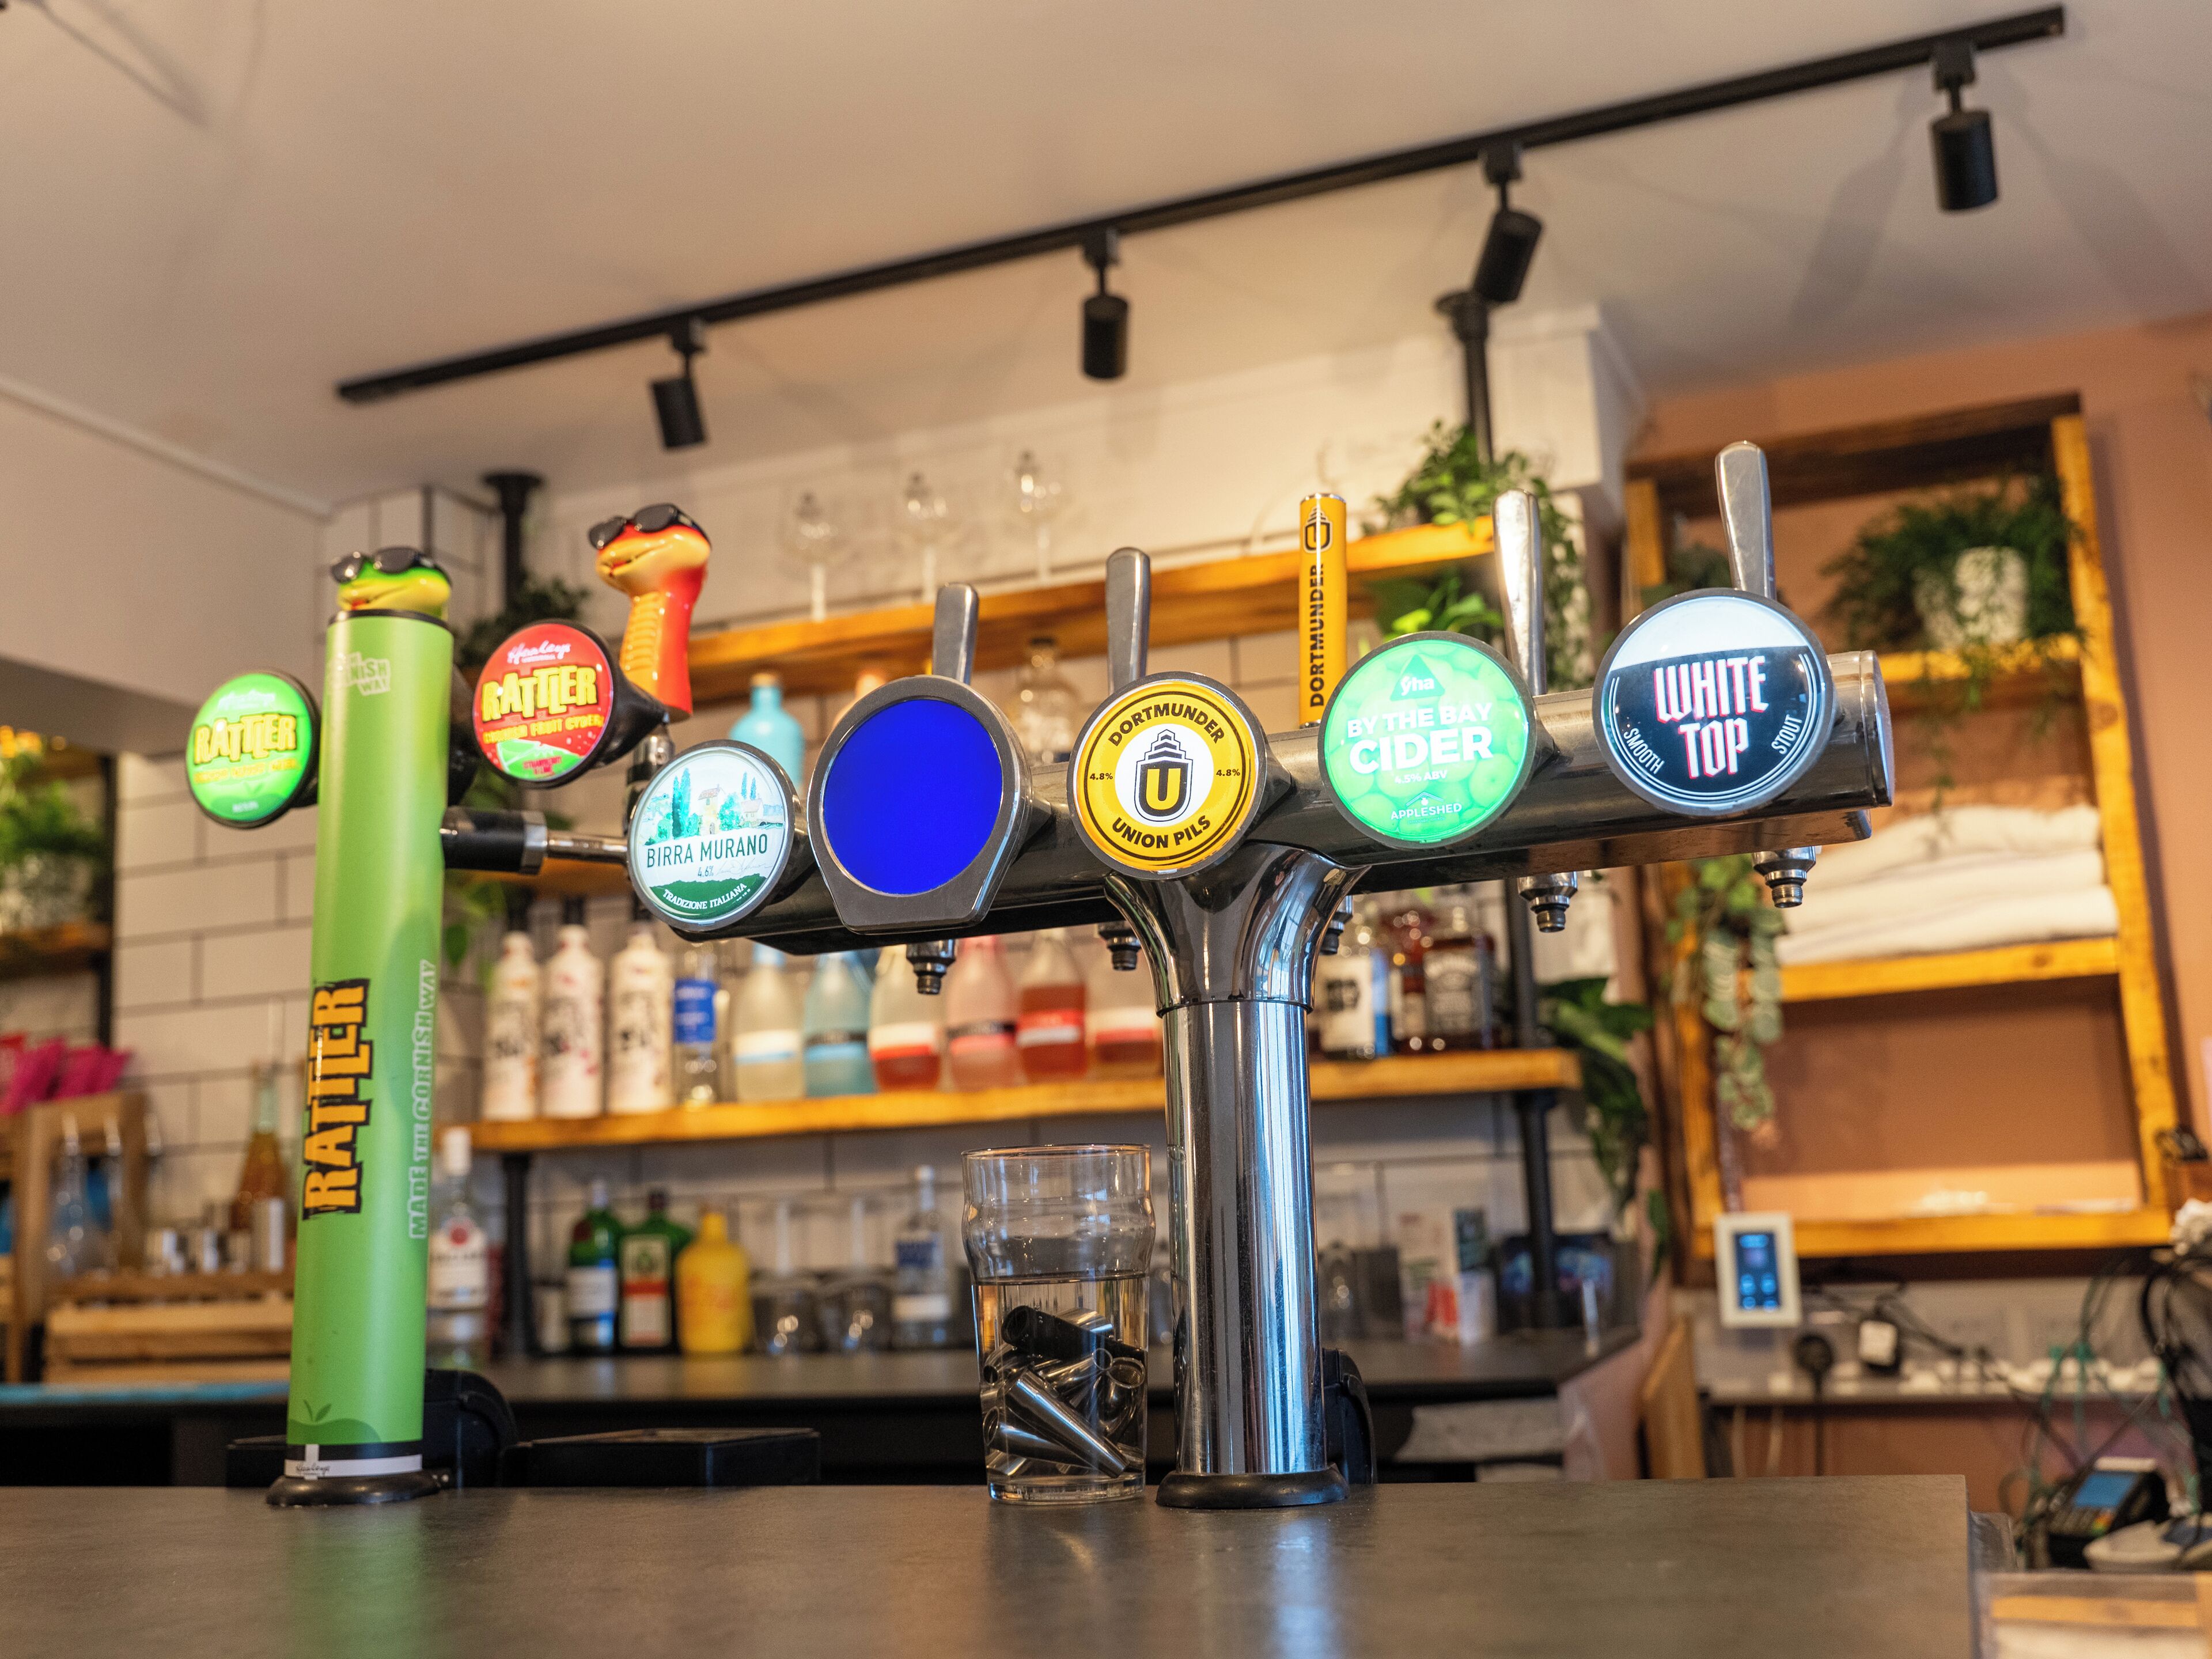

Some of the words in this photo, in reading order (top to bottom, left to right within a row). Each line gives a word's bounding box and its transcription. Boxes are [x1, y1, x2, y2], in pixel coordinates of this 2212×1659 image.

[1310, 563, 1324, 707] DORTMUNDER
[482, 665, 597, 722] RATTLER
[1400, 676, 1435, 696] yha
[1653, 655, 1770, 724] WHITE
[194, 714, 297, 764] RATTLER
[530, 718, 562, 737] FRUIT
[1108, 703, 1225, 747] DORTMUNDER
[1347, 715, 1378, 738] BY
[1382, 707, 1435, 731] THE
[1440, 703, 1493, 725] BAY
[1771, 714, 1803, 755] STOUT
[1349, 726, 1494, 775] CIDER
[1623, 728, 1665, 774] SMOOTH
[1678, 717, 1749, 779] TOP
[1215, 768, 1241, 777] 4.8%
[1423, 770, 1448, 781] ABV
[1112, 817, 1169, 849] UNION
[1173, 815, 1211, 846] PILS
[1391, 803, 1463, 820] APPLESHED
[647, 843, 694, 868] BIRRA
[700, 834, 768, 861] MURANO
[663, 889, 708, 910] TRADIZIONE
[710, 882, 747, 908] ITALIANA
[419, 959, 437, 1010] WAY
[412, 1010, 433, 1122] CORNISH
[302, 978, 373, 1221] RATTLER
[413, 1123, 430, 1162] THE
[407, 1166, 429, 1239] MADE
